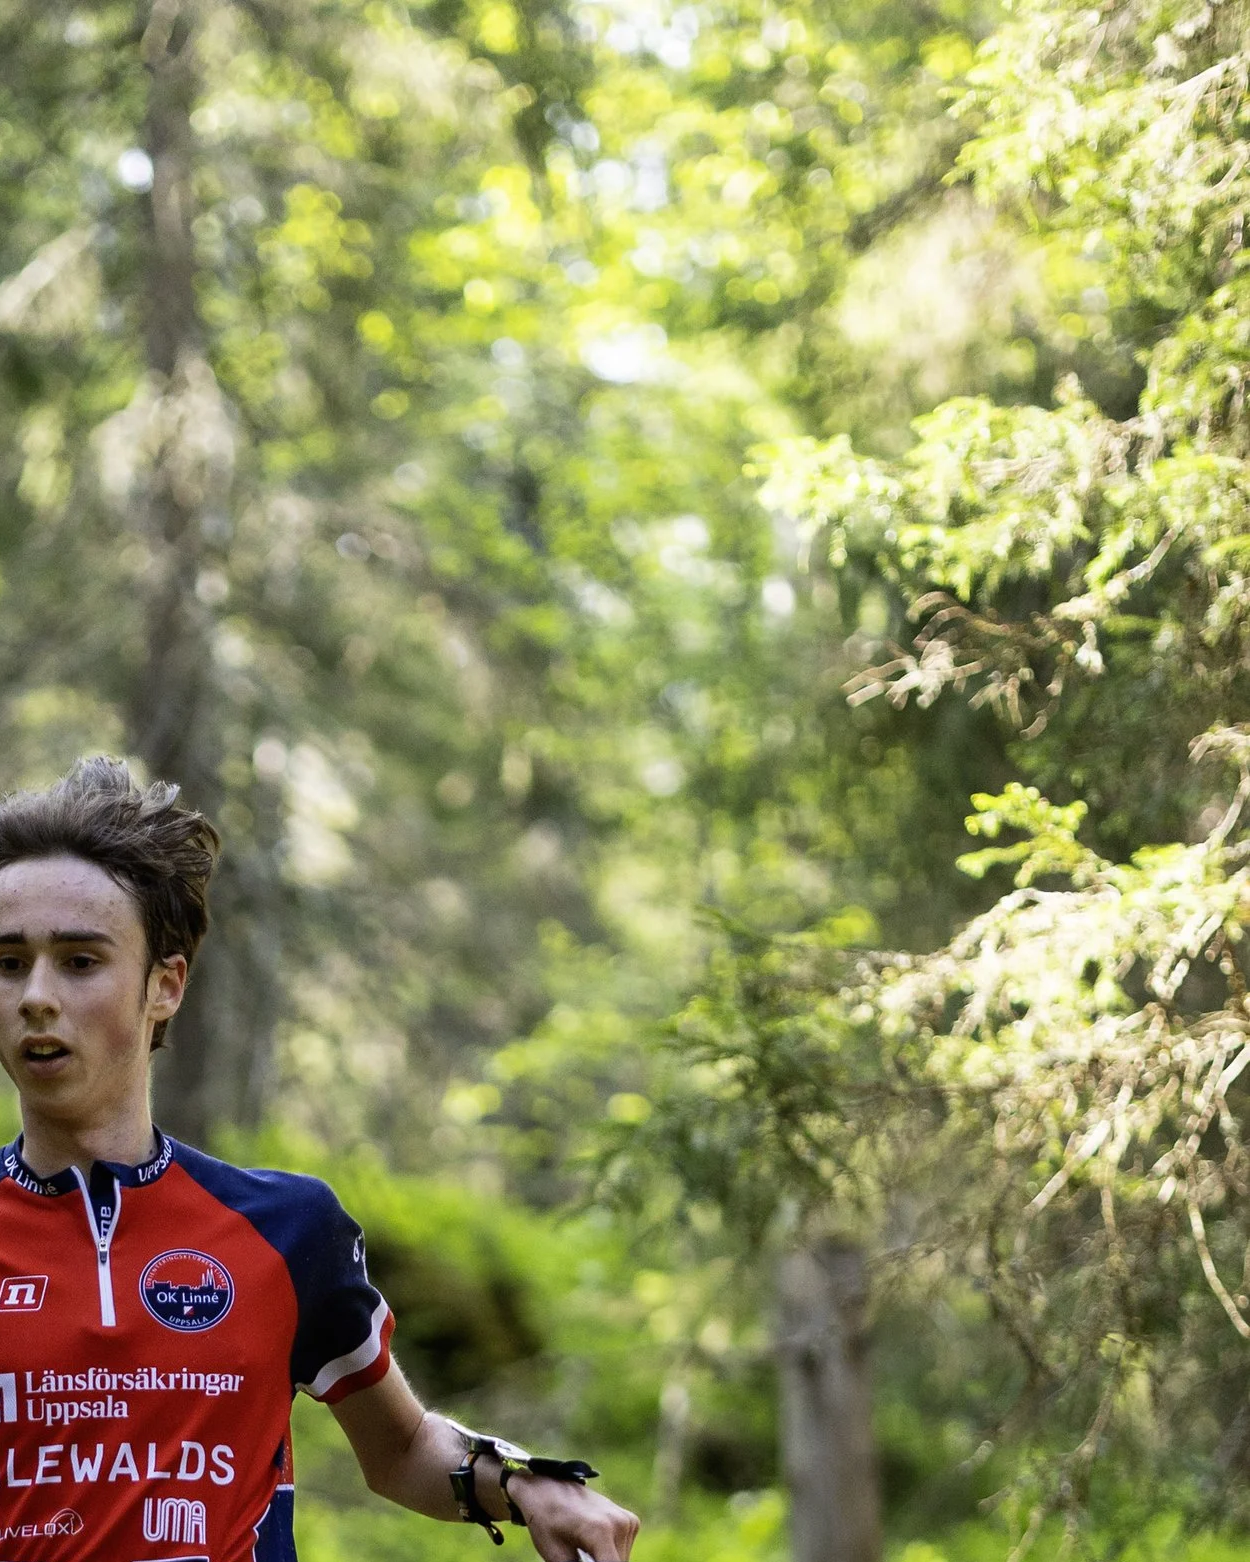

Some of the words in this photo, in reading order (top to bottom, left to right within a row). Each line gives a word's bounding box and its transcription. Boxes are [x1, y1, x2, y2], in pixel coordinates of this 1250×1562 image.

[4, 1153, 20, 1177] OK
[156, 1291, 178, 1303] OK
[182, 1291, 220, 1304] Linné
[168, 1315, 209, 1327] UPPSALA
[25, 1367, 244, 1396] Länsförsäkringar
[27, 1395, 129, 1426] Uppsala
[142, 1497, 207, 1545] UMA
